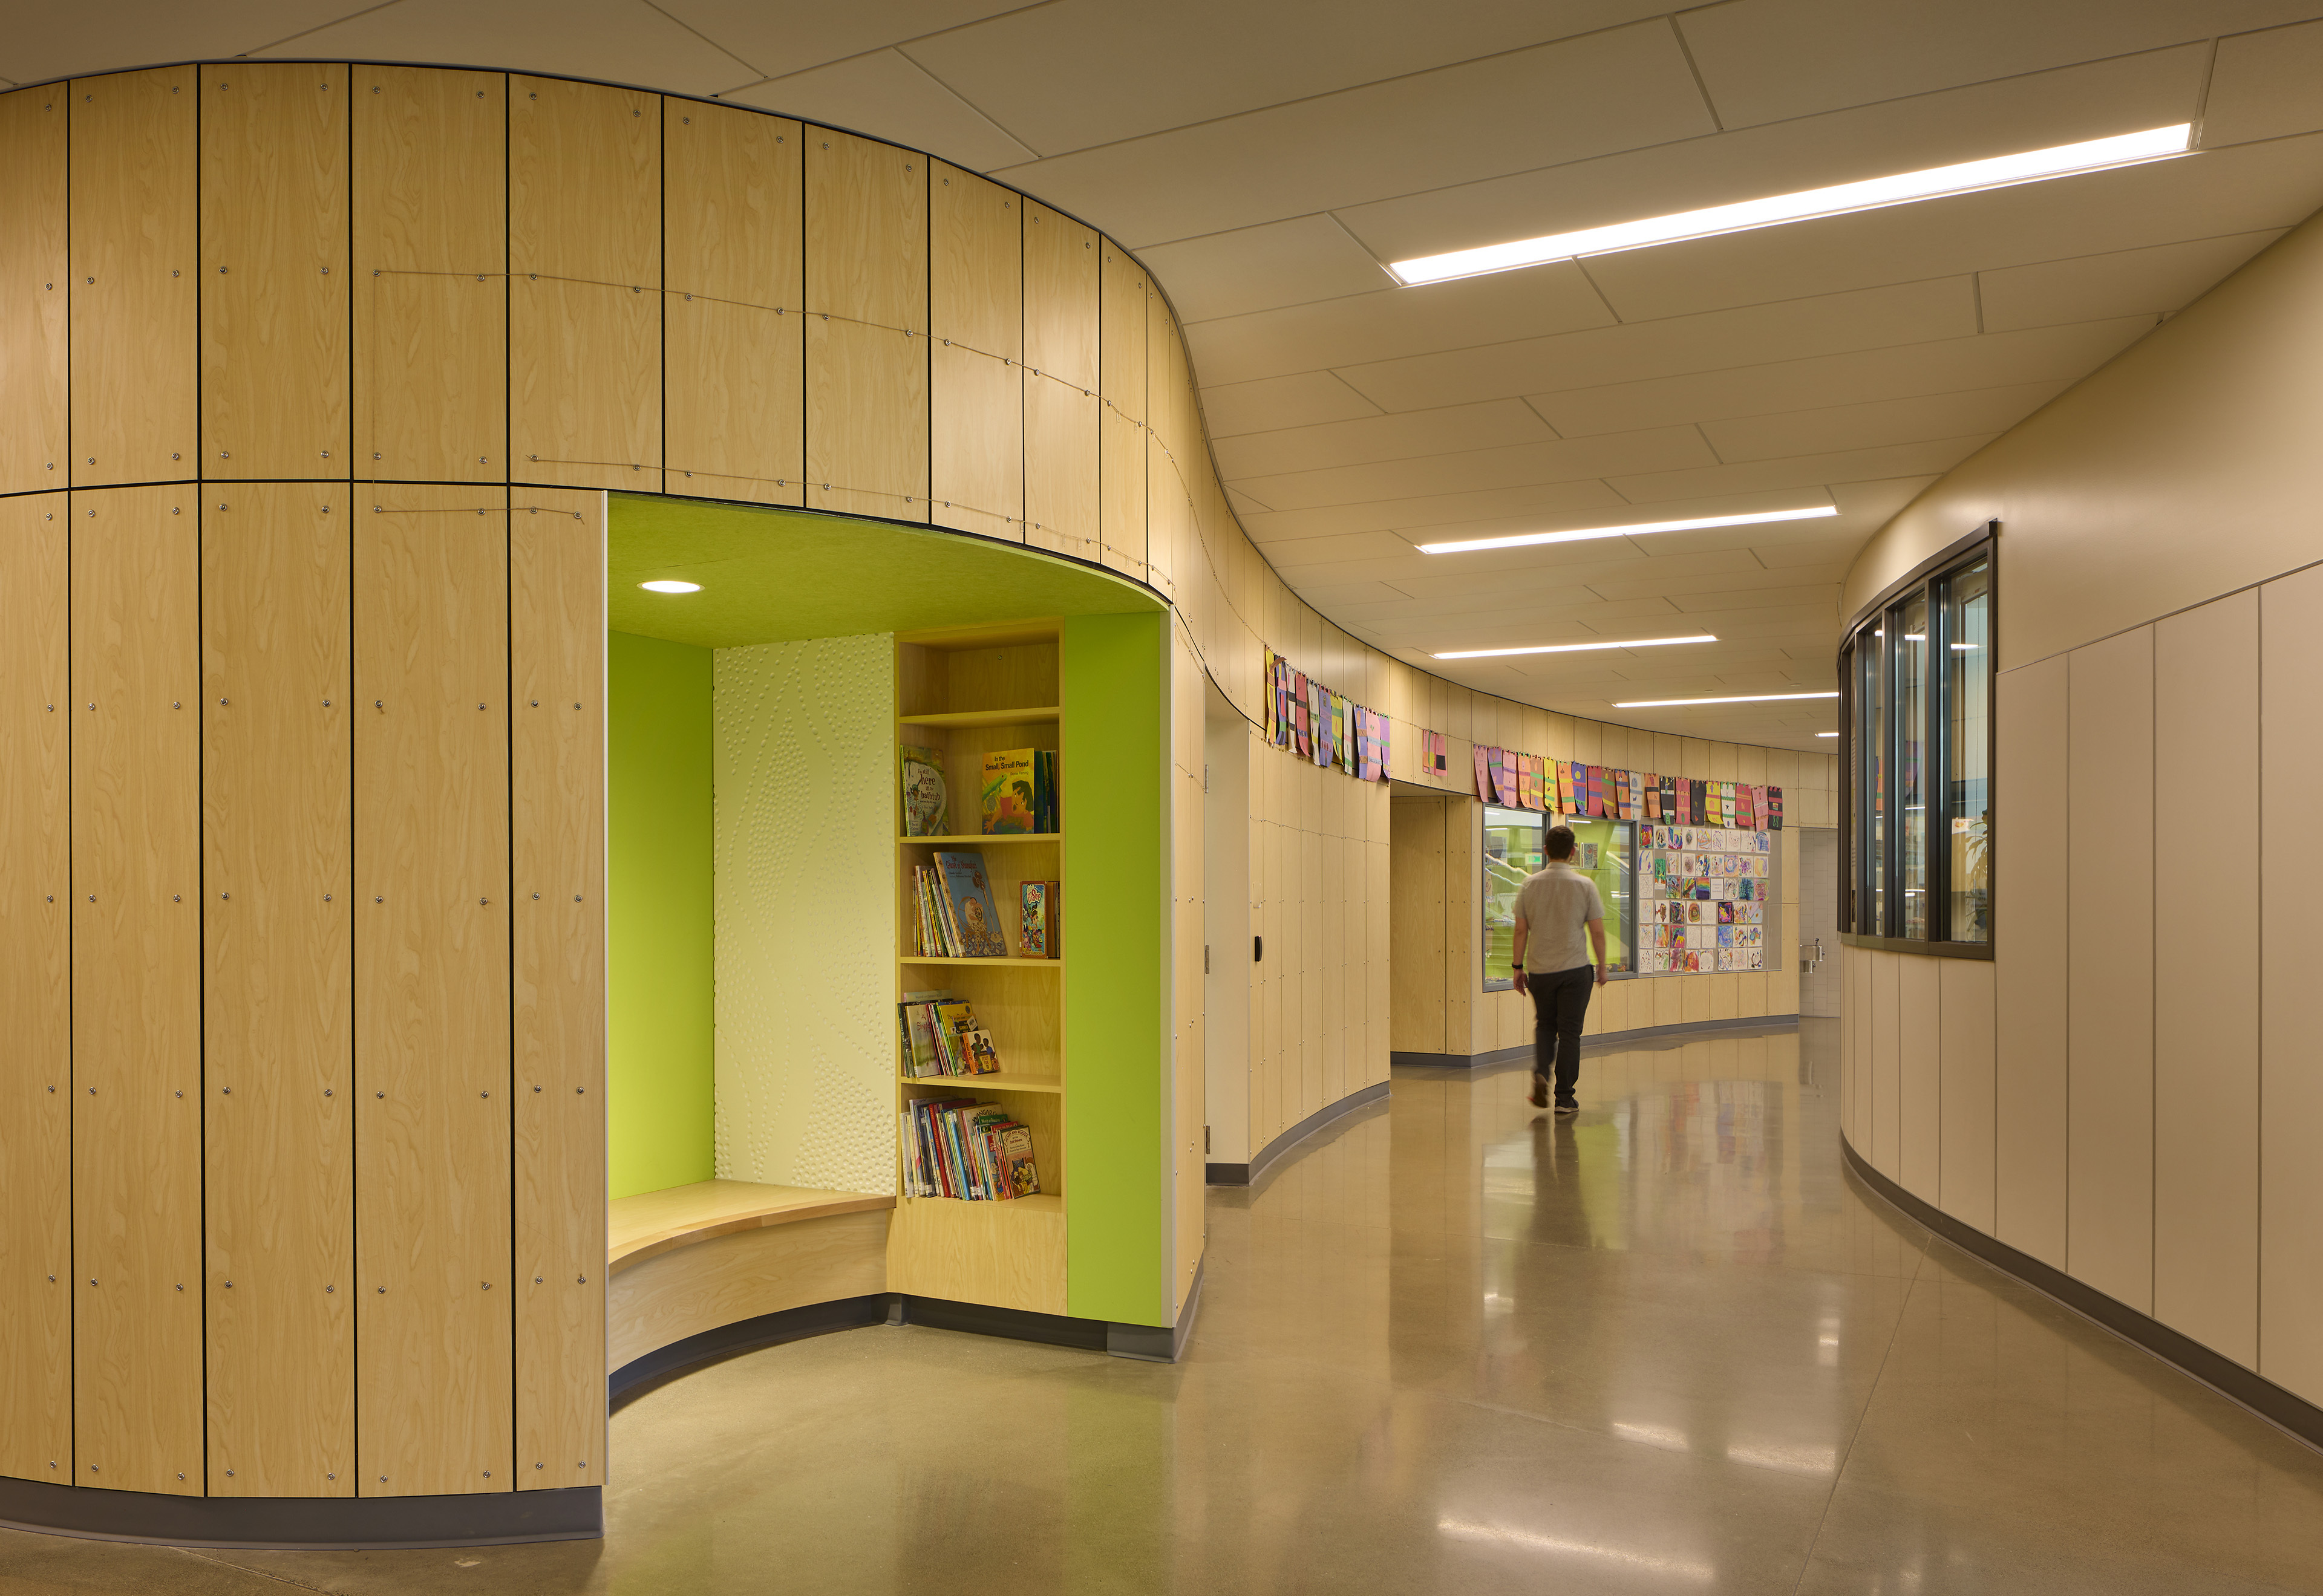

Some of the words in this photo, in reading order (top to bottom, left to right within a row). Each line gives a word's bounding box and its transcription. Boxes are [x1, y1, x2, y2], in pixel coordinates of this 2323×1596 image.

[920, 774, 936, 786] here
[921, 790, 941, 801] bathtub
[946, 859, 957, 869] Ghost
[961, 860, 977, 872] Shanghai
